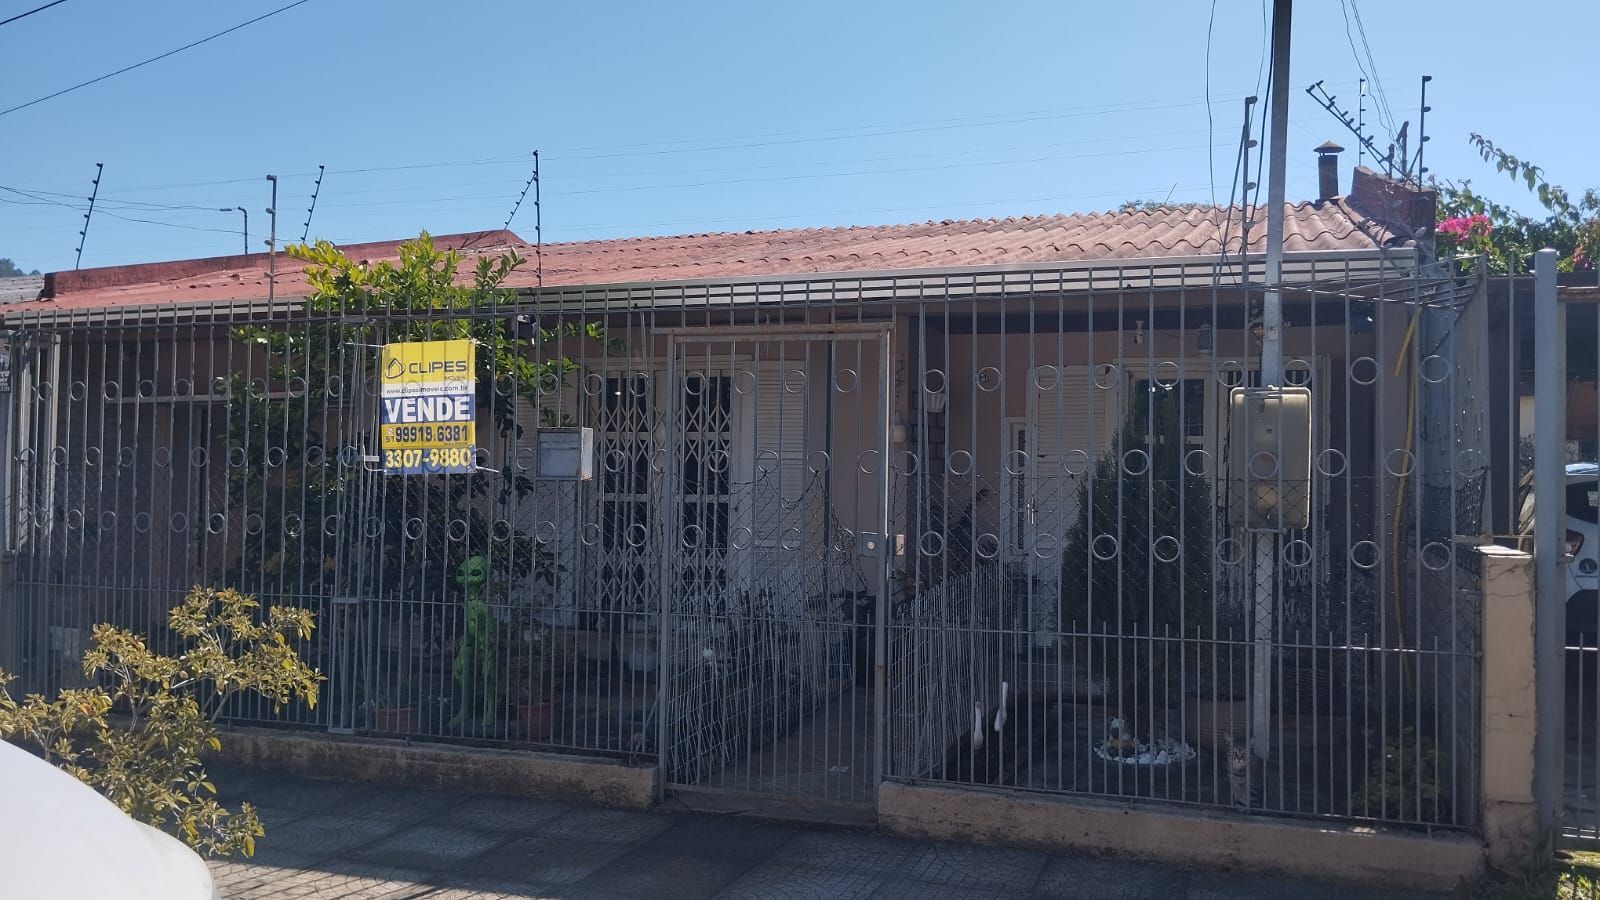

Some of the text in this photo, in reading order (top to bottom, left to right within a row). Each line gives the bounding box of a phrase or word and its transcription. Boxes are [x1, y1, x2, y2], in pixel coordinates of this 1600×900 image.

[408, 360, 467, 374] CLIPES
[384, 396, 471, 423] VENDE
[395, 425, 468, 443] 99919.6381
[385, 447, 472, 468] 3307-9880
